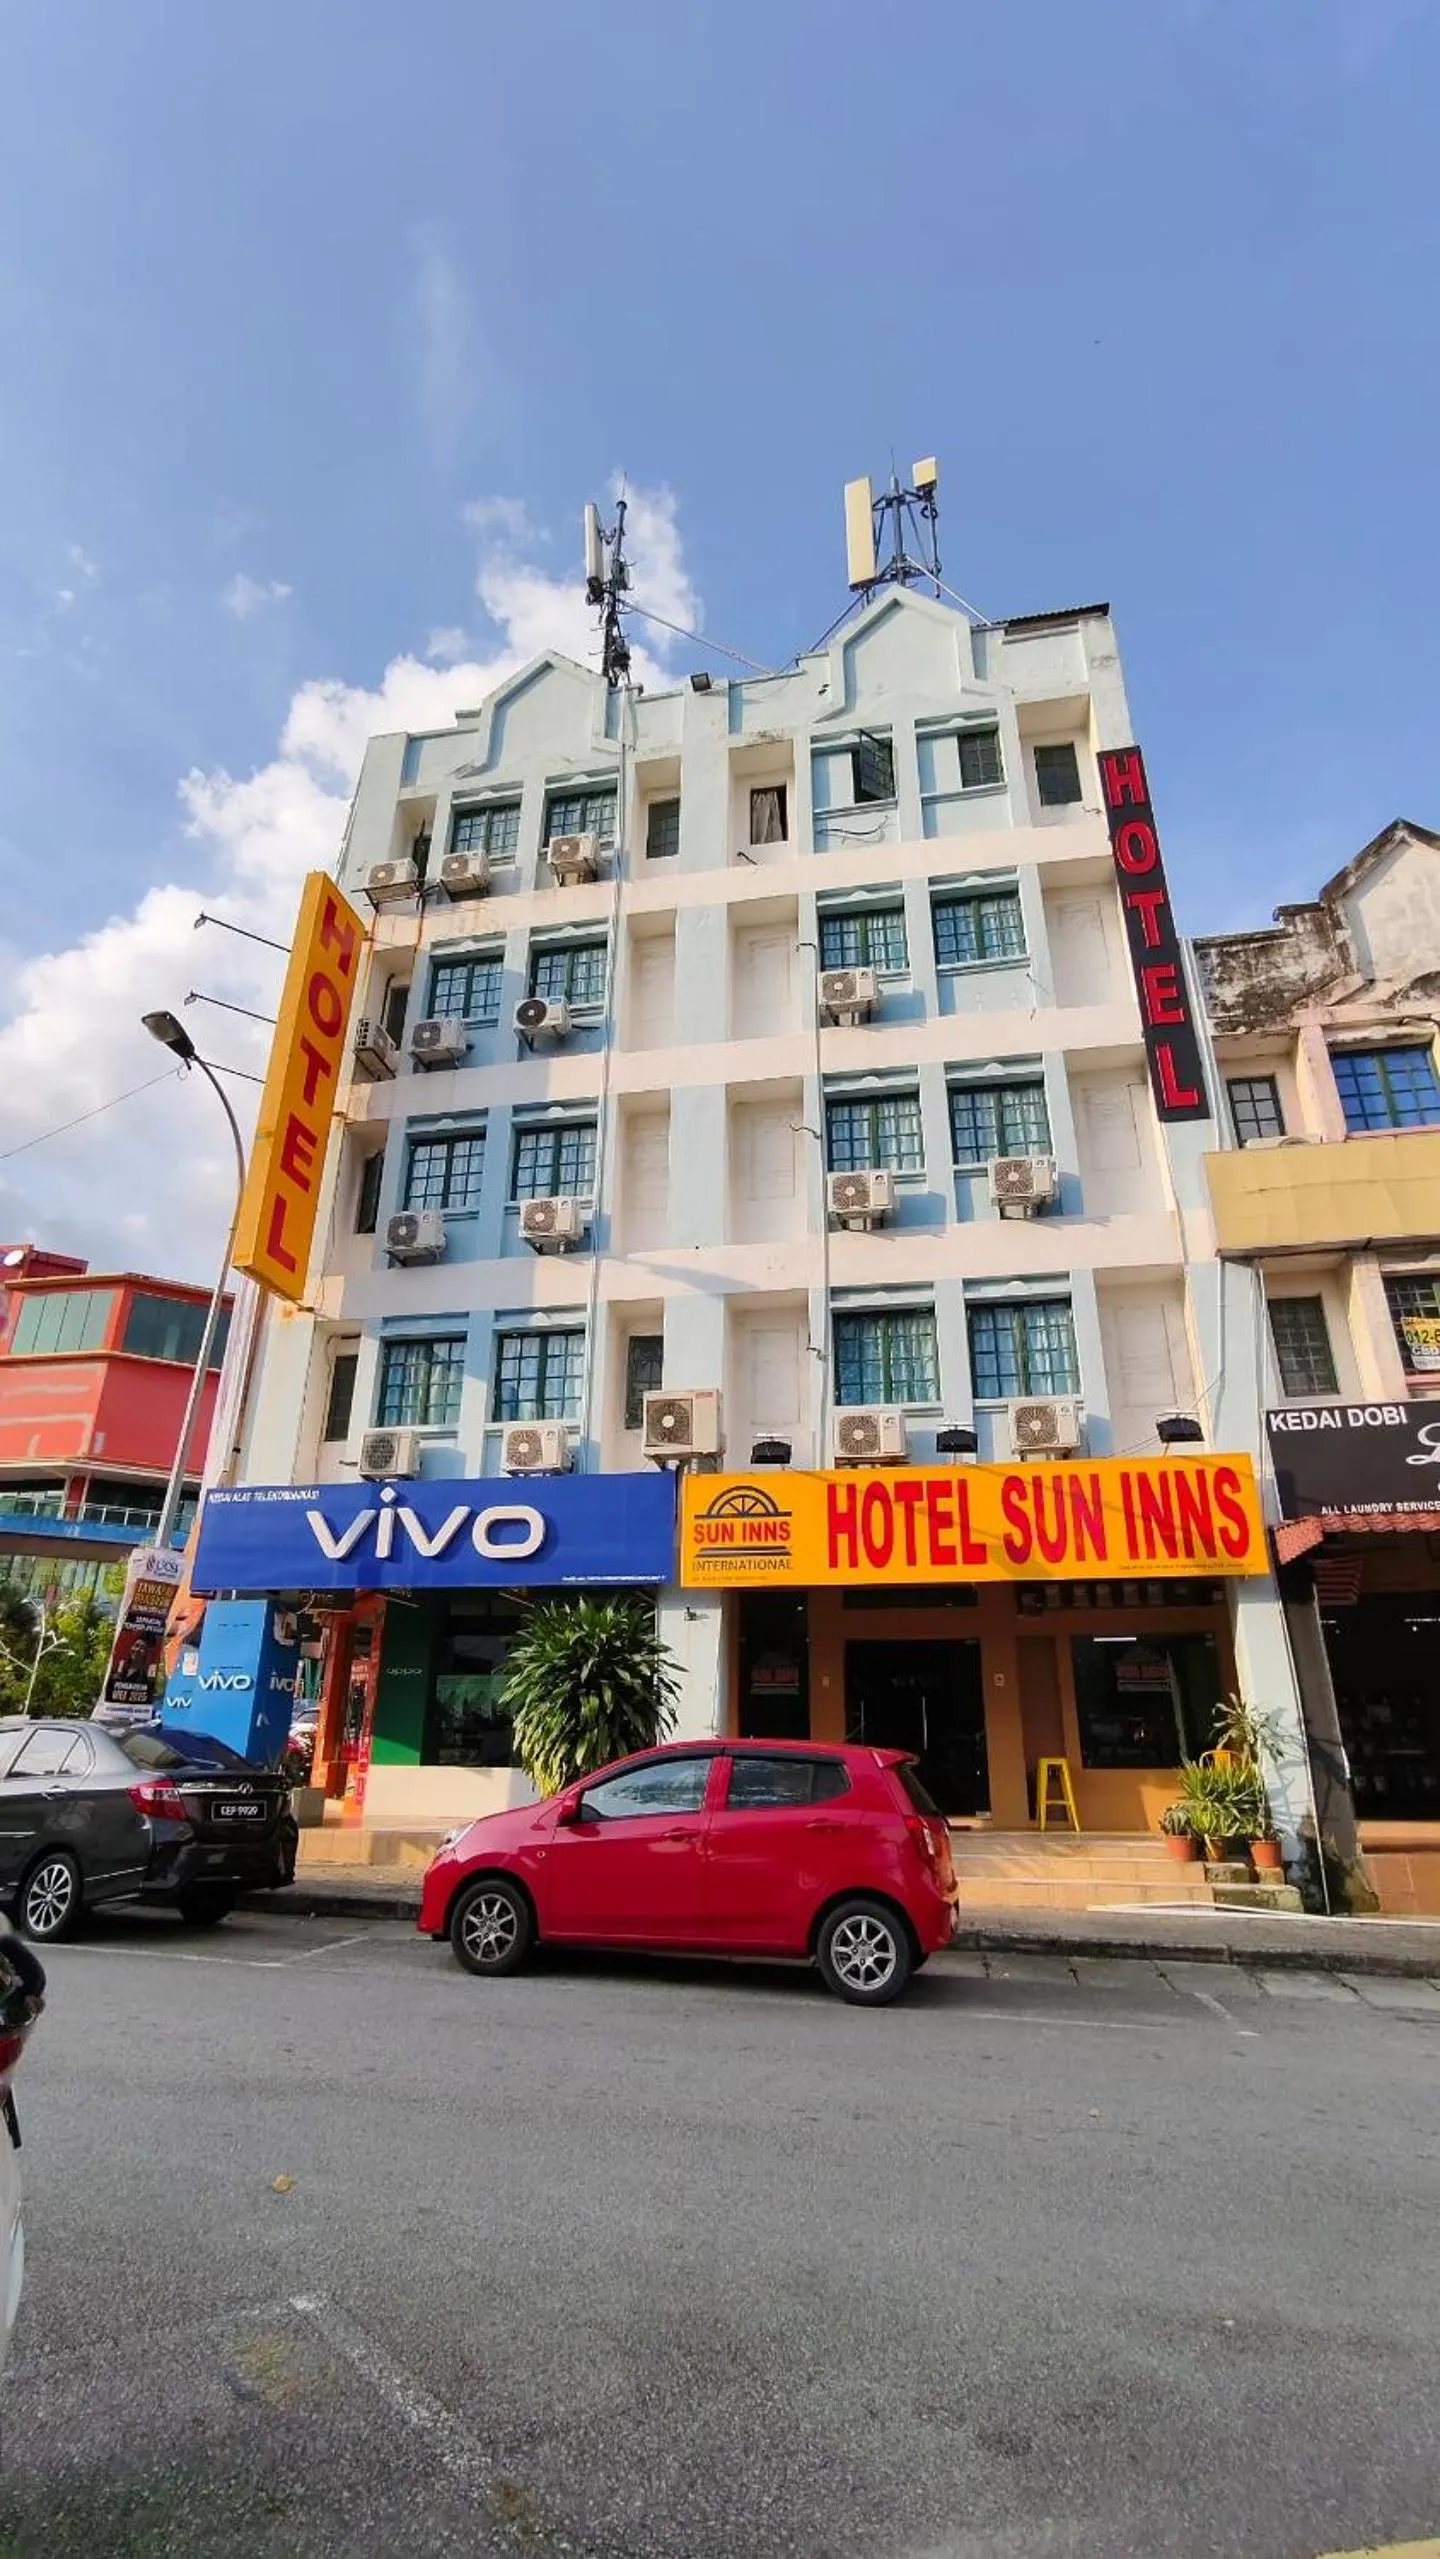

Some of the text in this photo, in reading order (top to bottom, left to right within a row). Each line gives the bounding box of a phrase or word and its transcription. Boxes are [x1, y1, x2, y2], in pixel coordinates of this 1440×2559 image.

[1103, 752, 1199, 1109] HOTEL
[268, 895, 356, 1273] HOTEL
[1269, 1405, 1408, 1432] KEDAI DOBI
[827, 1466, 1251, 1569] HOTEL SUN INNS
[1321, 1505, 1341, 1515] ALL
[1343, 1502, 1393, 1514] LAUNDRY
[306, 1486, 546, 1559] vivo
[693, 1520, 791, 1544] SUN INNS
[692, 1557, 794, 1571] INTERNATIONAL
[198, 1671, 252, 1691] vivo
